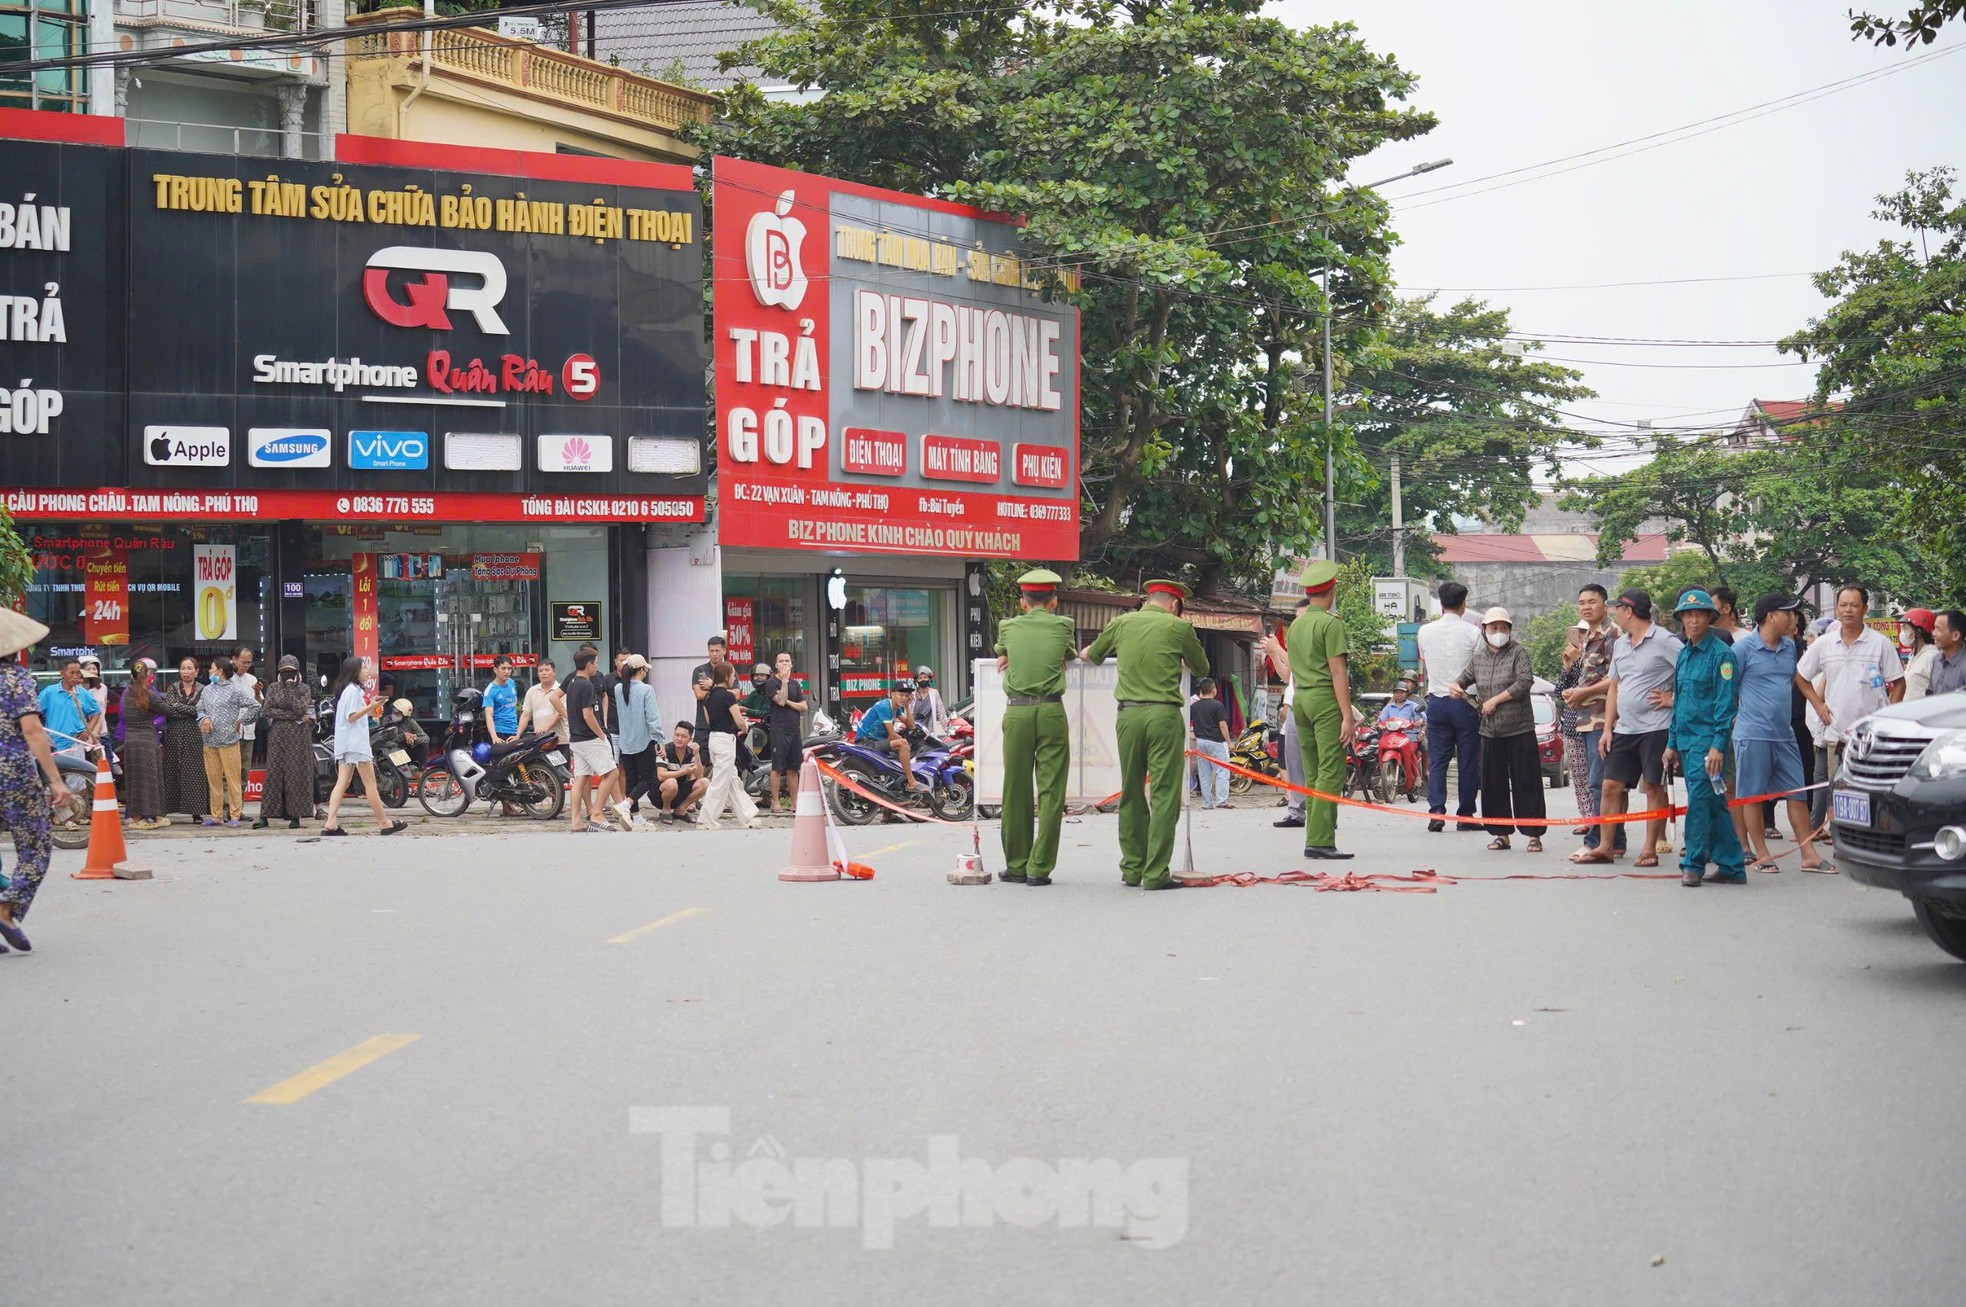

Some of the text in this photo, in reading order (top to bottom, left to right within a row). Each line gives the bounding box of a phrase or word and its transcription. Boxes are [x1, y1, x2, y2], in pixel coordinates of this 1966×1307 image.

[153, 172, 693, 250] TRUNG TÂM SỬA CHỮA BẢO HÀNH ĐIỆN THOẠI
[363, 246, 511, 335] QR
[729, 318, 821, 391] TRẢ
[854, 289, 1061, 411] BIZPHONE
[253, 350, 597, 396] Smartphone Quân Râu 5
[264, 442, 318, 455] SAMSUNG
[727, 397, 826, 469] GÓP
[174, 440, 226, 462] Apple
[849, 434, 903, 472] ĐIỆN THOẠI
[928, 441, 998, 475] MÁY TÍNH BẢNG
[1022, 451, 1062, 485] PHỤ KIỆN
[39, 494, 87, 512] PHONG
[234, 496, 258, 517] THỌ
[353, 497, 435, 514] 0836 776 555
[522, 494, 552, 516] TỔNG
[555, 497, 574, 516] ĐÀI
[611, 500, 638, 517] 0210
[640, 501, 649, 517] 6
[650, 501, 694, 517] 505050
[751, 484, 762, 502] 22
[762, 486, 780, 506] VẠN
[781, 484, 805, 505] XUÂN
[811, 489, 829, 507] TAM
[829, 487, 852, 508] NÔNG
[873, 494, 889, 513] THỌ
[788, 519, 1021, 551] BIZ PHONE KÍNH CHÀO QUÝ KHÁCH
[198, 549, 232, 581] TRẢ GÓP
[157, 583, 180, 592] MOBILE
[285, 584, 301, 592] 100
[93, 600, 121, 620] 24h
[199, 586, 228, 640] 0
[729, 625, 751, 646] 50%
[846, 678, 881, 691] BIZ PHONE
